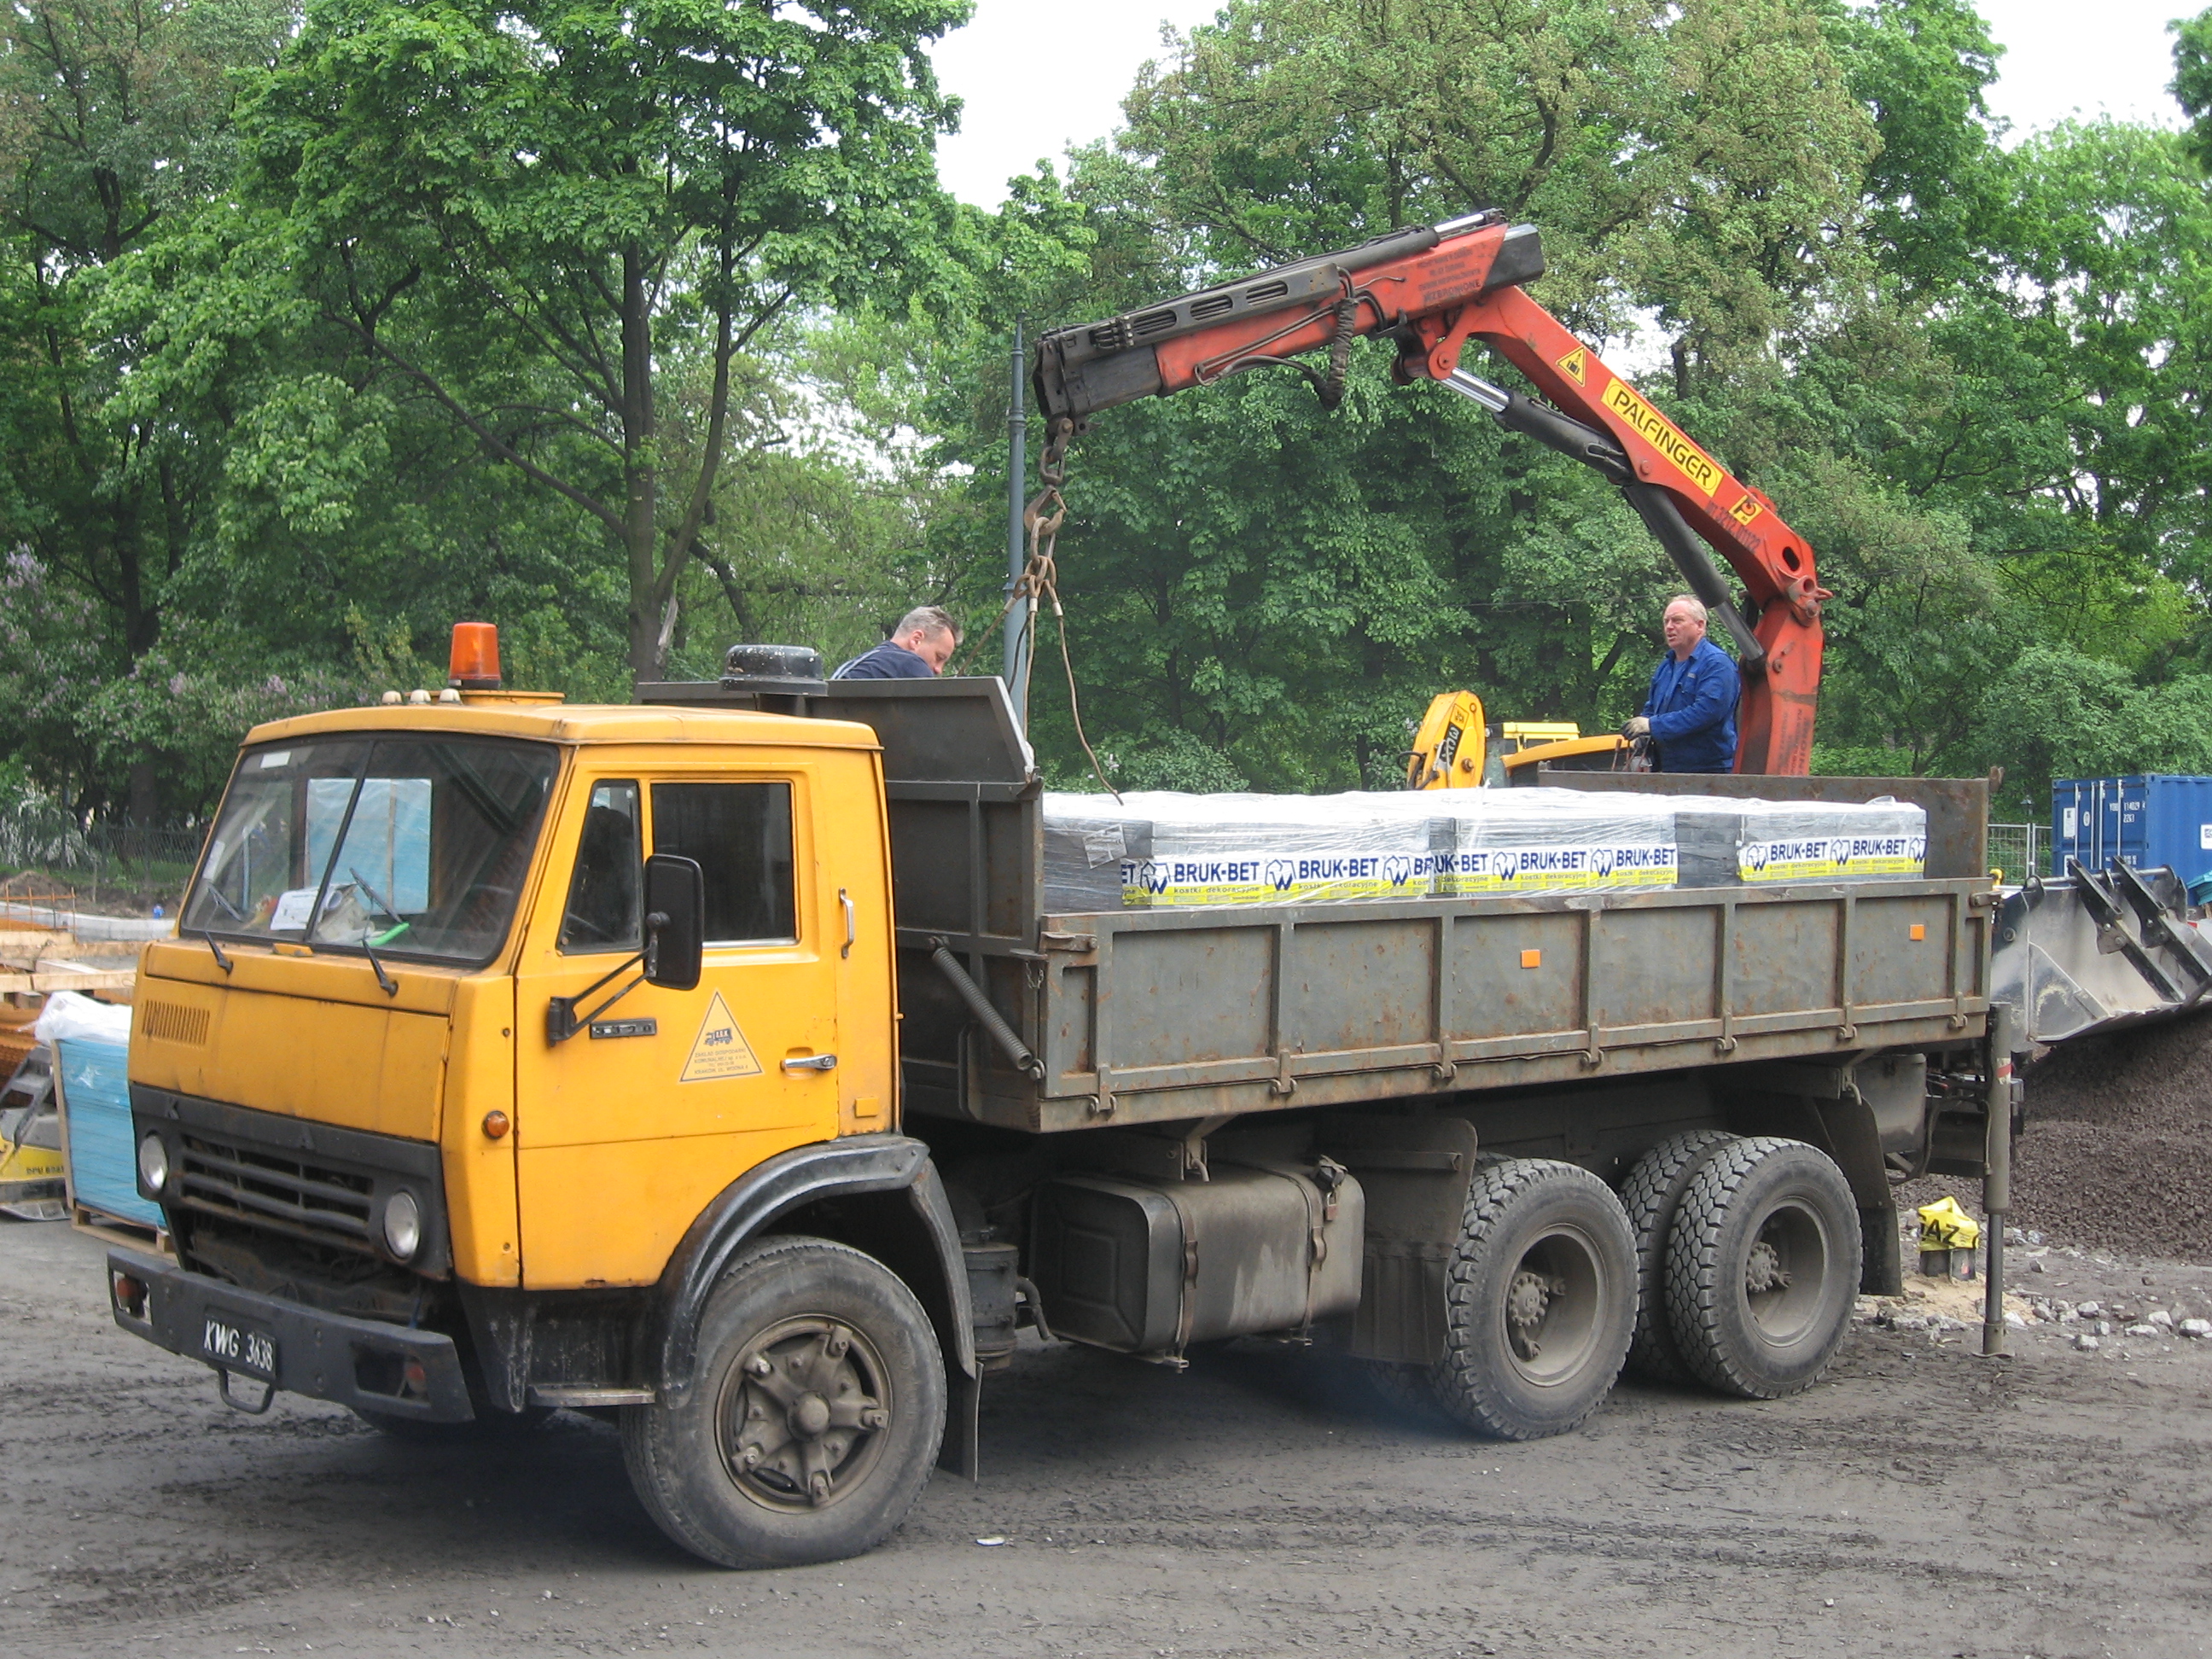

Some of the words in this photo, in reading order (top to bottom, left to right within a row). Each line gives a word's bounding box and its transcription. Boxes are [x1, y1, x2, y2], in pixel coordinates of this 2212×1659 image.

[1613, 389, 1712, 486] PALFINGER
[1174, 862, 1260, 882] BRUK-BET
[1299, 858, 1378, 879] BRUK-BET
[1520, 851, 1586, 870] BRUK-BET
[1616, 848, 1676, 867] BRUK-BET
[1770, 841, 1827, 862] BRUK-BET
[1852, 839, 1906, 857] BRUK-BET
[1206, 886, 1259, 894] dekoracyjne
[204, 1320, 240, 1357] KWG
